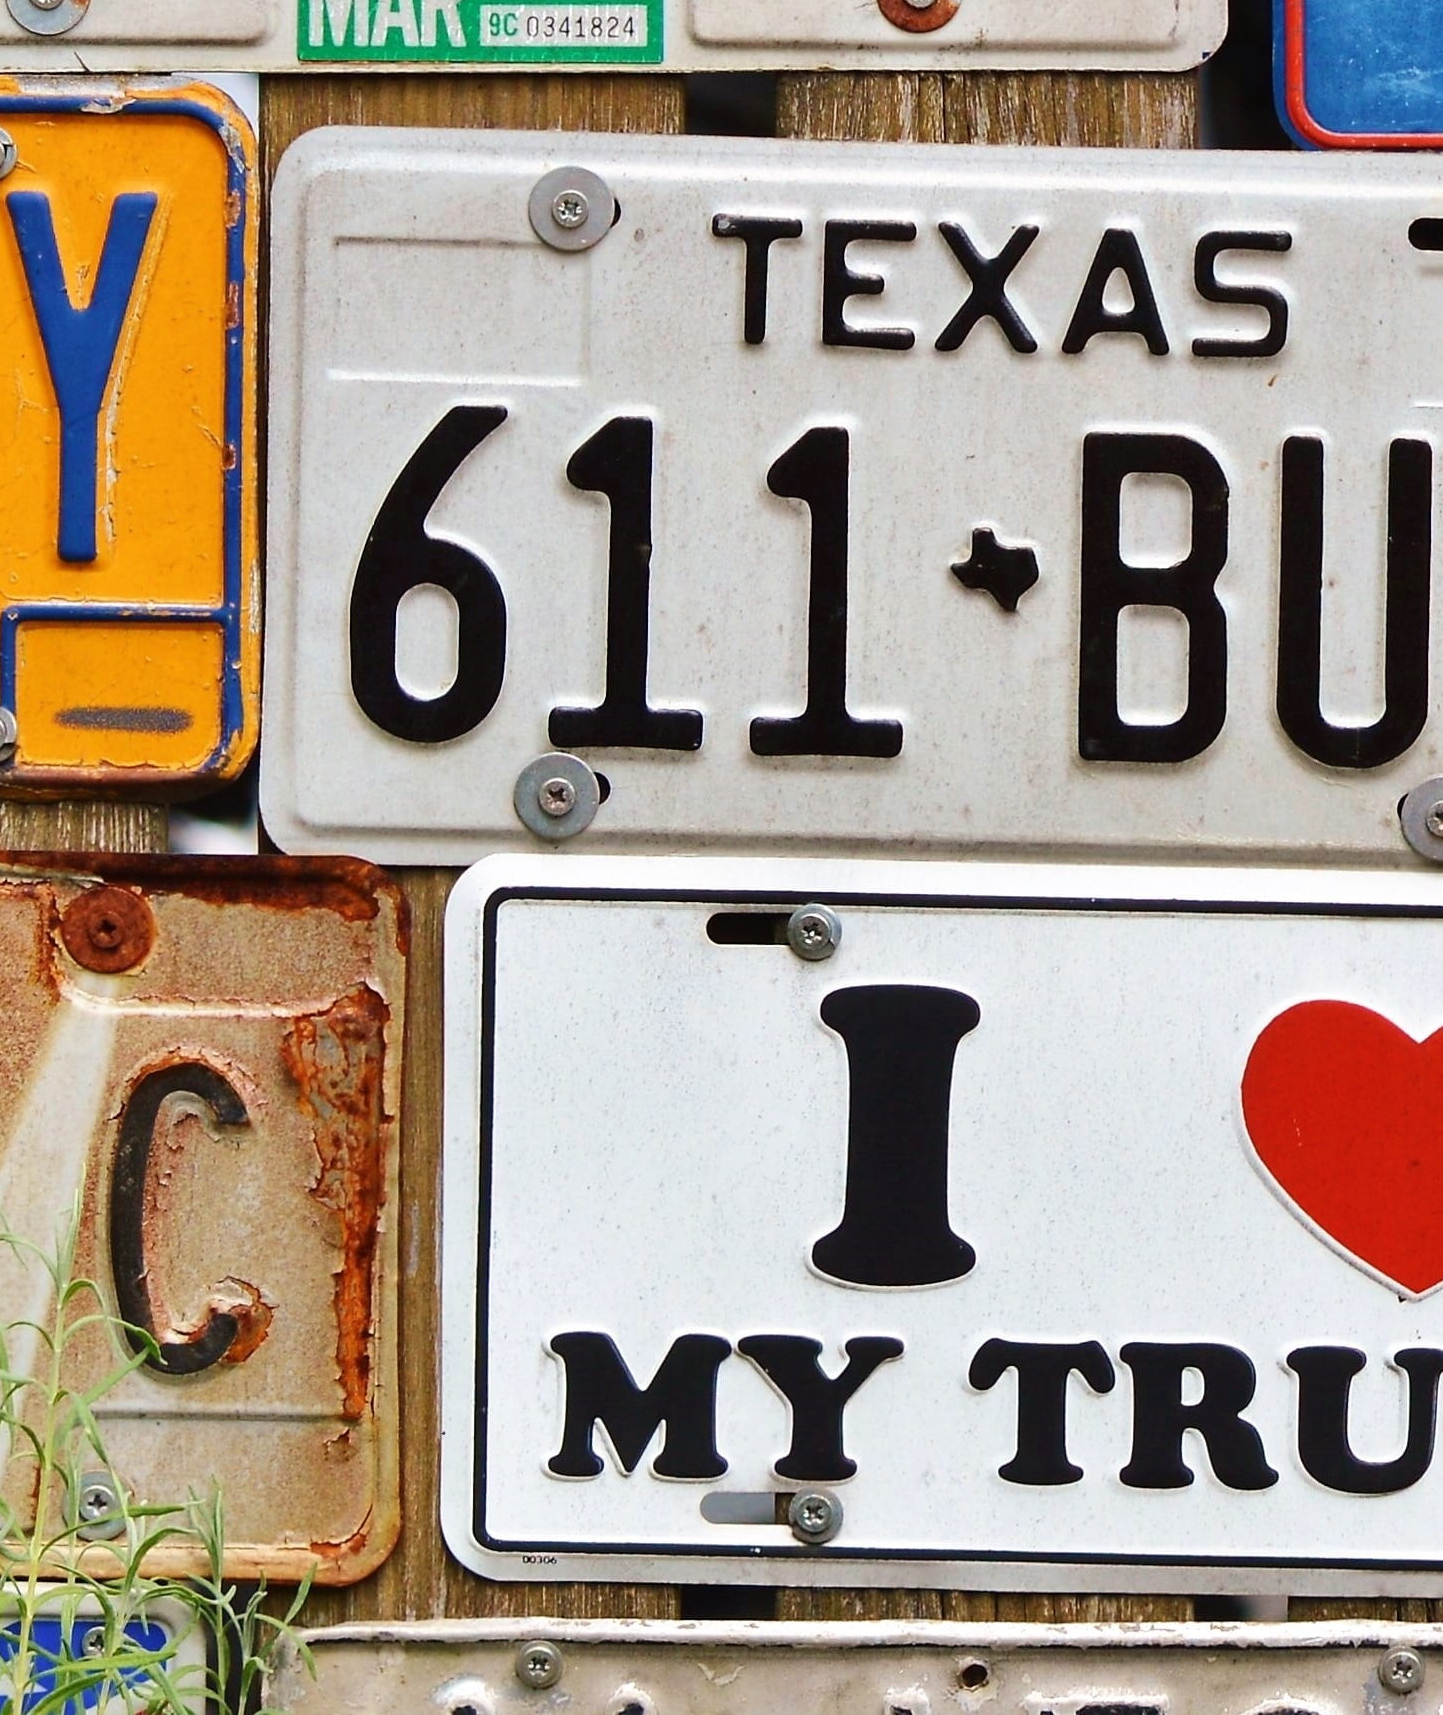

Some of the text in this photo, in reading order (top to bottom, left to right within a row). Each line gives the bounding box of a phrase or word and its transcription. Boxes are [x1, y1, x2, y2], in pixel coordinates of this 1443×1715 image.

[489, 13, 633, 37] 9C 0341824
[712, 212, 1293, 358] TEXAS
[350, 406, 903, 763] 611
[812, 985, 980, 1286] I
[548, 1332, 904, 1484] MY
